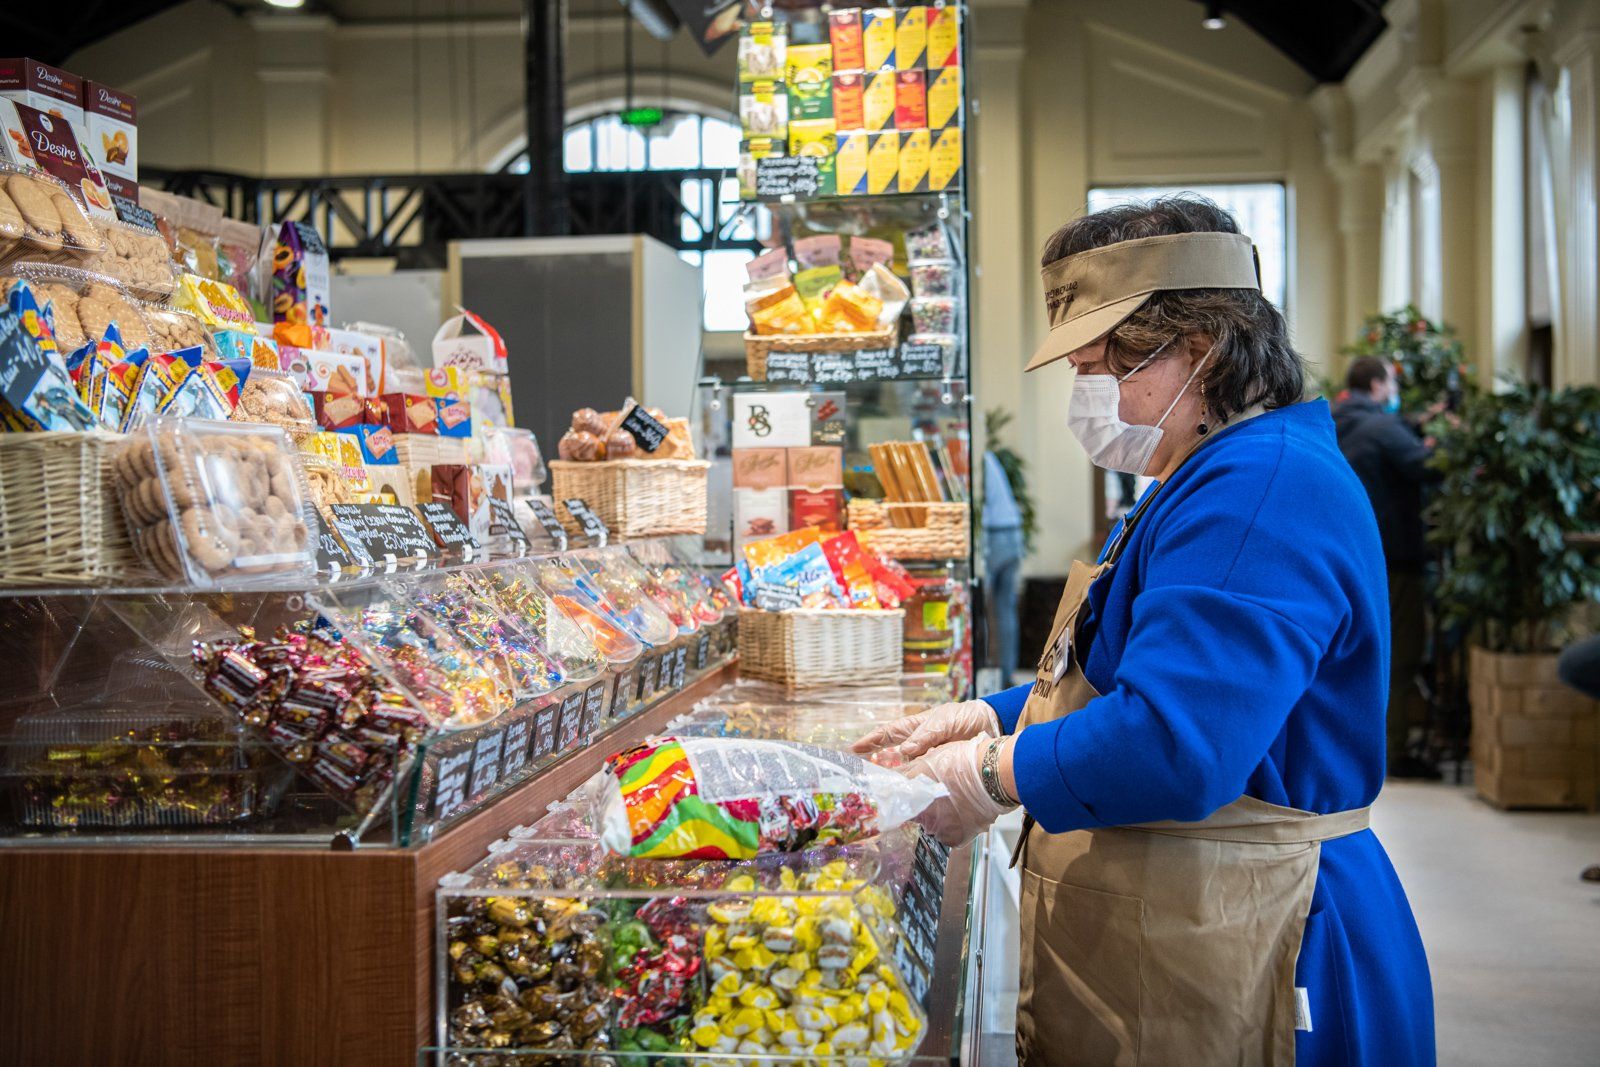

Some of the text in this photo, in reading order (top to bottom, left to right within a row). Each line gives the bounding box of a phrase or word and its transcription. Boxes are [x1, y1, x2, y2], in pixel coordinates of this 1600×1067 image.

[36, 66, 63, 85] Desire
[98, 88, 121, 106] Desire
[31, 130, 76, 160] Desire
